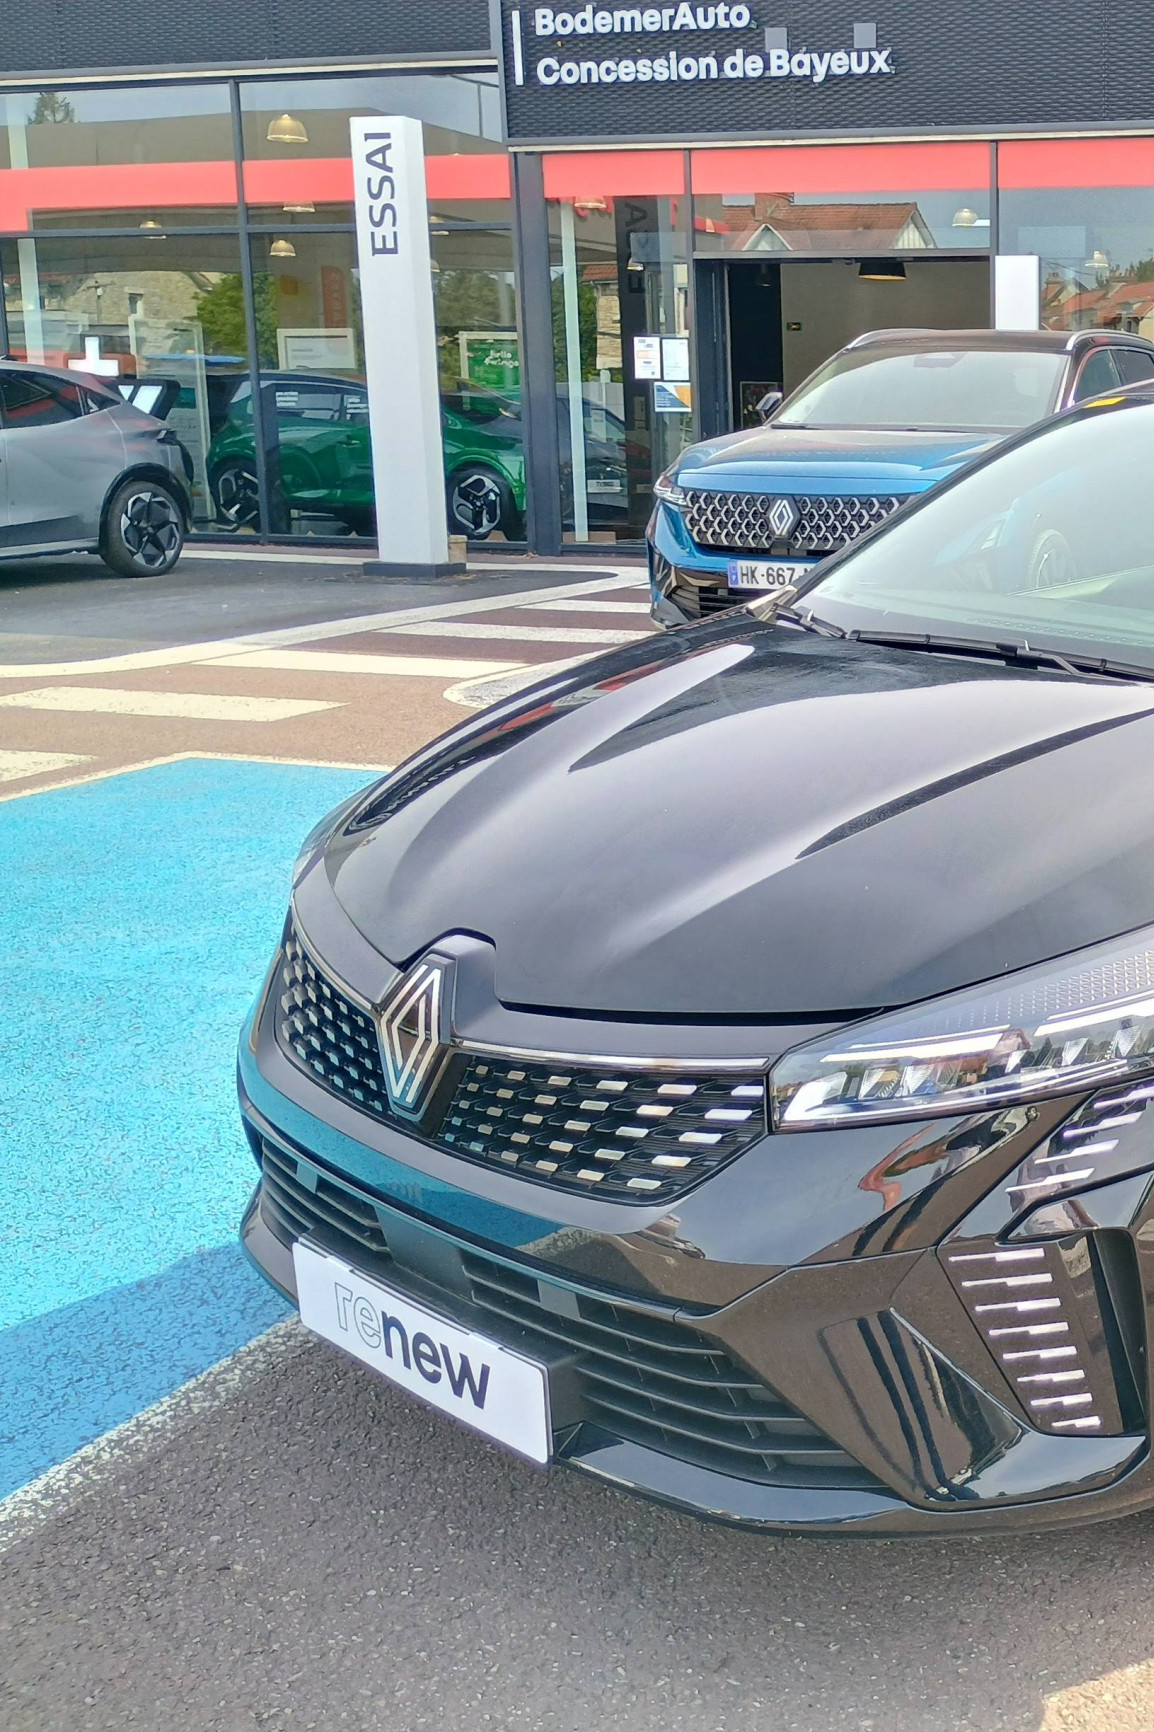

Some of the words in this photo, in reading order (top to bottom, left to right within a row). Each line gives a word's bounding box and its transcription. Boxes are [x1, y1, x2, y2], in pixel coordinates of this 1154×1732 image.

[534, 3, 751, 36] BodemerAuto
[536, 51, 718, 85] Concession
[724, 49, 764, 78] de
[769, 48, 893, 83] Bayeux
[364, 132, 398, 256] ESSAI
[740, 565, 812, 586] HK-667
[334, 1281, 490, 1410] renew
